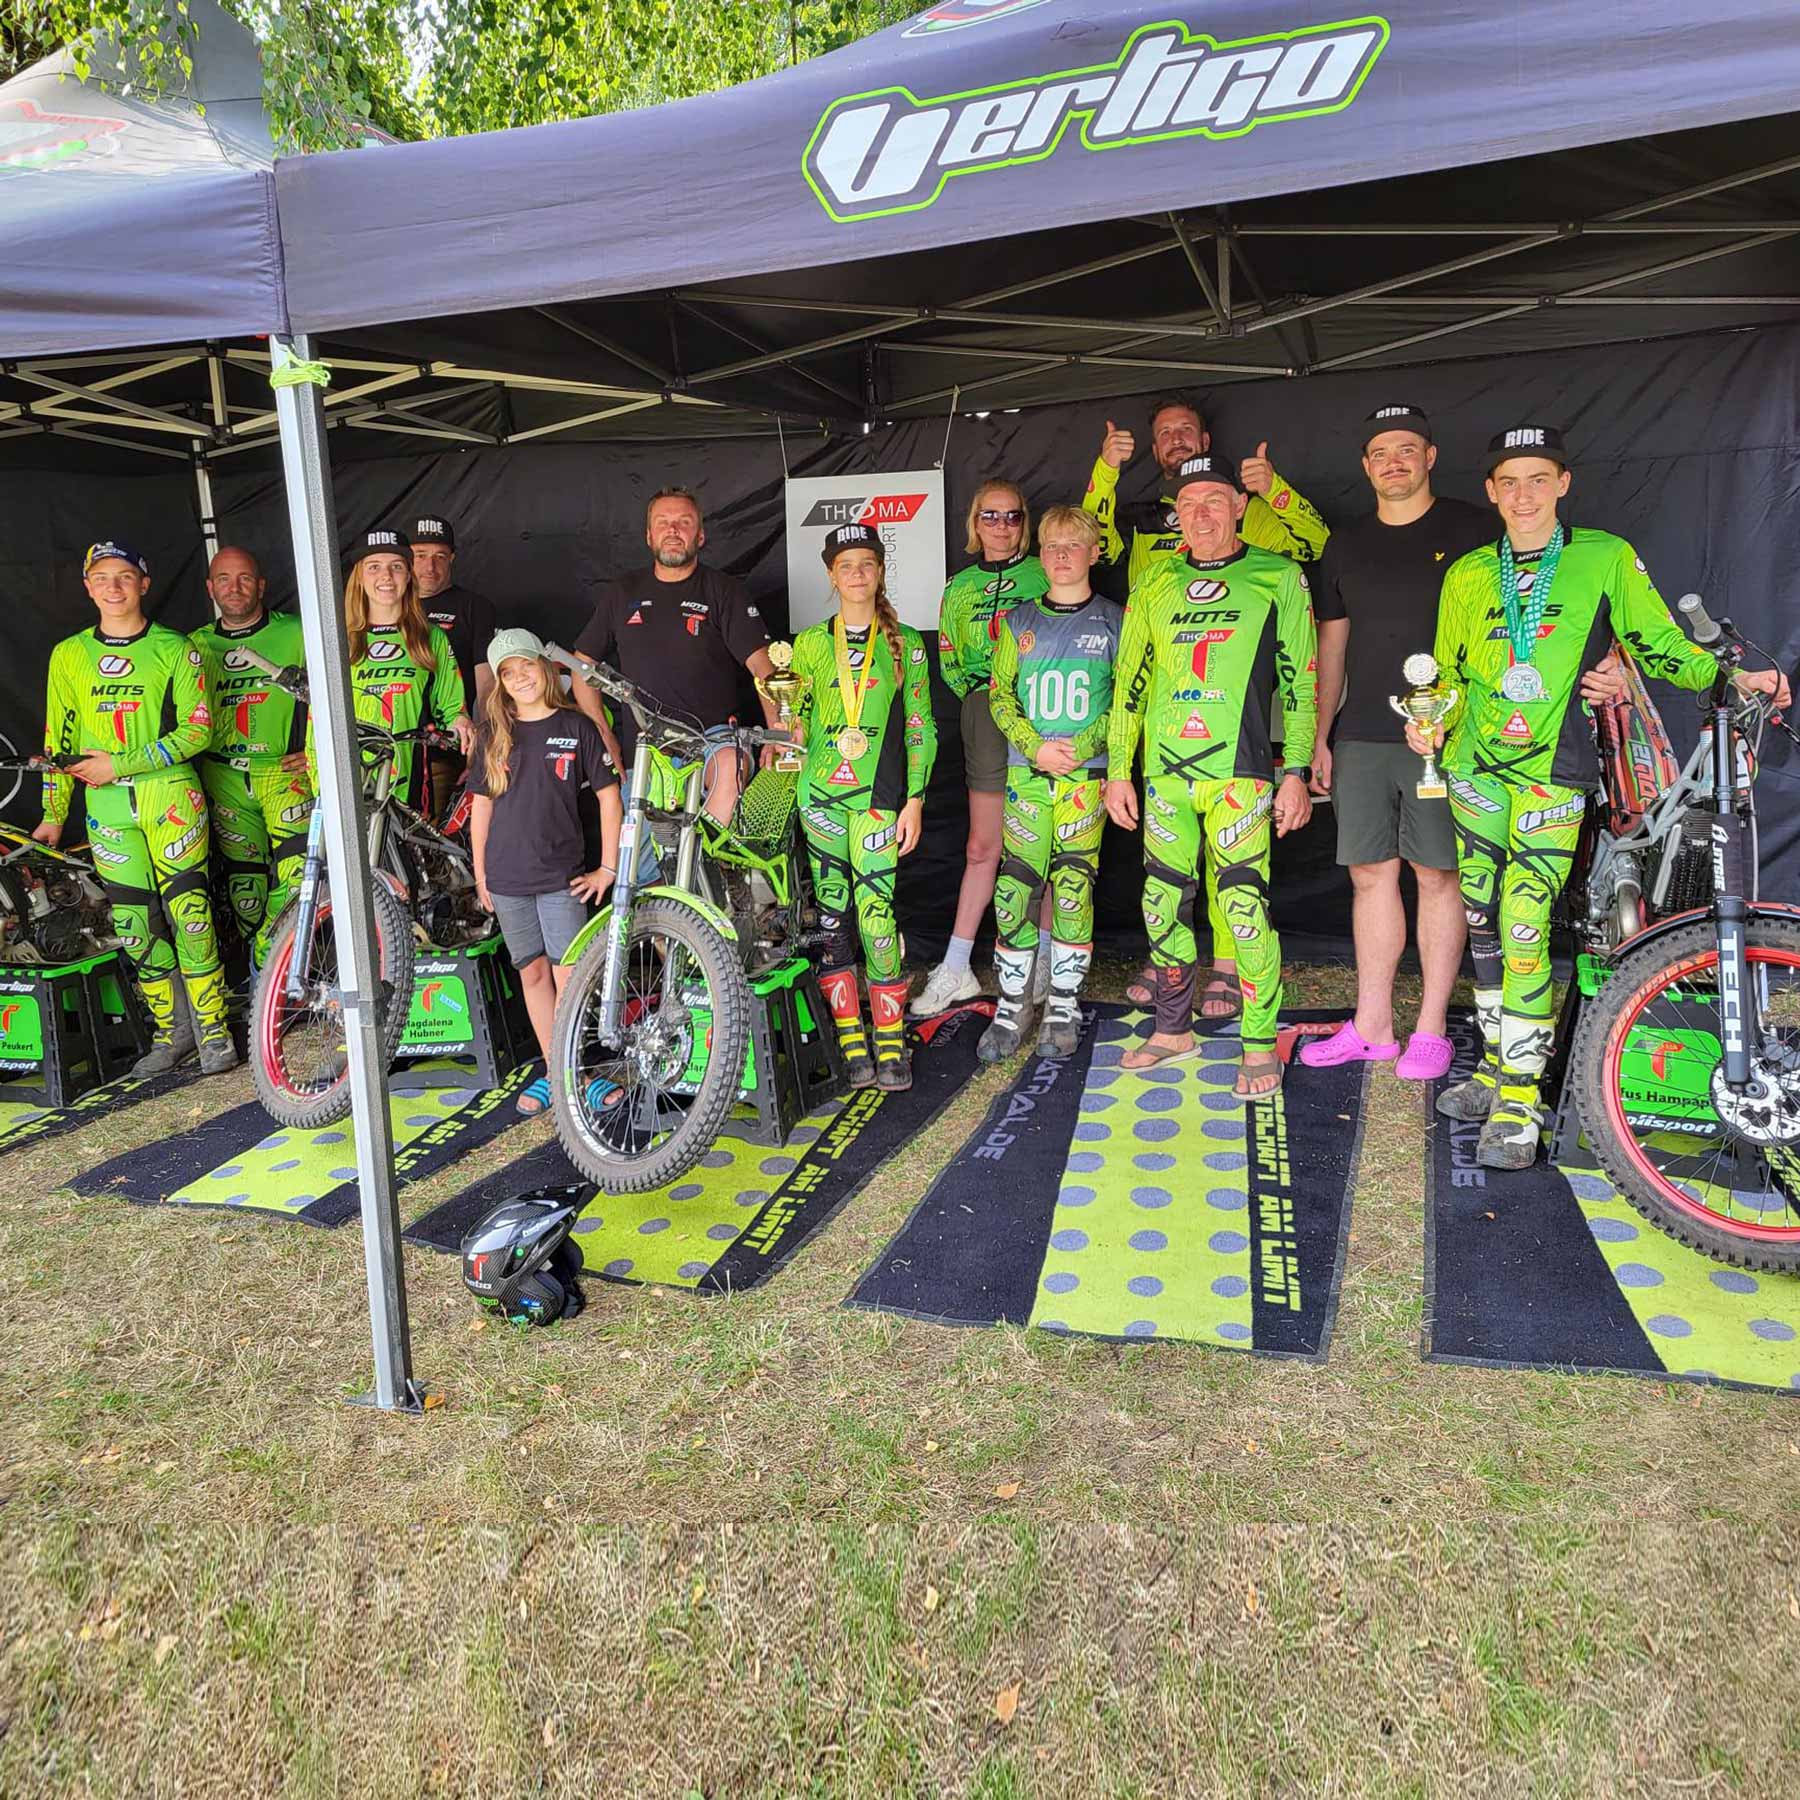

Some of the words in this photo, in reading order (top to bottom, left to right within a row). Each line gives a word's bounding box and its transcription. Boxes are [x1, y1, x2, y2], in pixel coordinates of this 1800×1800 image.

[816, 31, 1377, 204] Vertigo
[1504, 429, 1545, 448] RIDE
[1180, 457, 1210, 476] RIDE
[820, 500, 909, 521] THOMA
[418, 520, 442, 535] RIDE
[837, 526, 869, 544] RIDE
[368, 532, 398, 546] RIDE
[1170, 611, 1242, 625] MOTS
[1078, 634, 1109, 651] FIM
[1180, 632, 1224, 642] THOMA
[358, 667, 416, 681] MOTS
[1125, 642, 1154, 714] MOTS
[91, 685, 145, 698] MOTS
[1025, 669, 1091, 721] 106
[61, 708, 77, 756] OTS
[414, 961, 458, 974] ertigo
[1721, 930, 1742, 1053] TECH
[2, 1041, 34, 1051] Peukert
[396, 1043, 465, 1056] Polisport
[0, 1059, 37, 1071] isport
[1626, 1114, 1718, 1134] olisport
[787, 1163, 831, 1193] AM
[1258, 1194, 1296, 1234] AM
[741, 1196, 807, 1256] LIMIT
[1260, 1238, 1302, 1312] LIMIT
